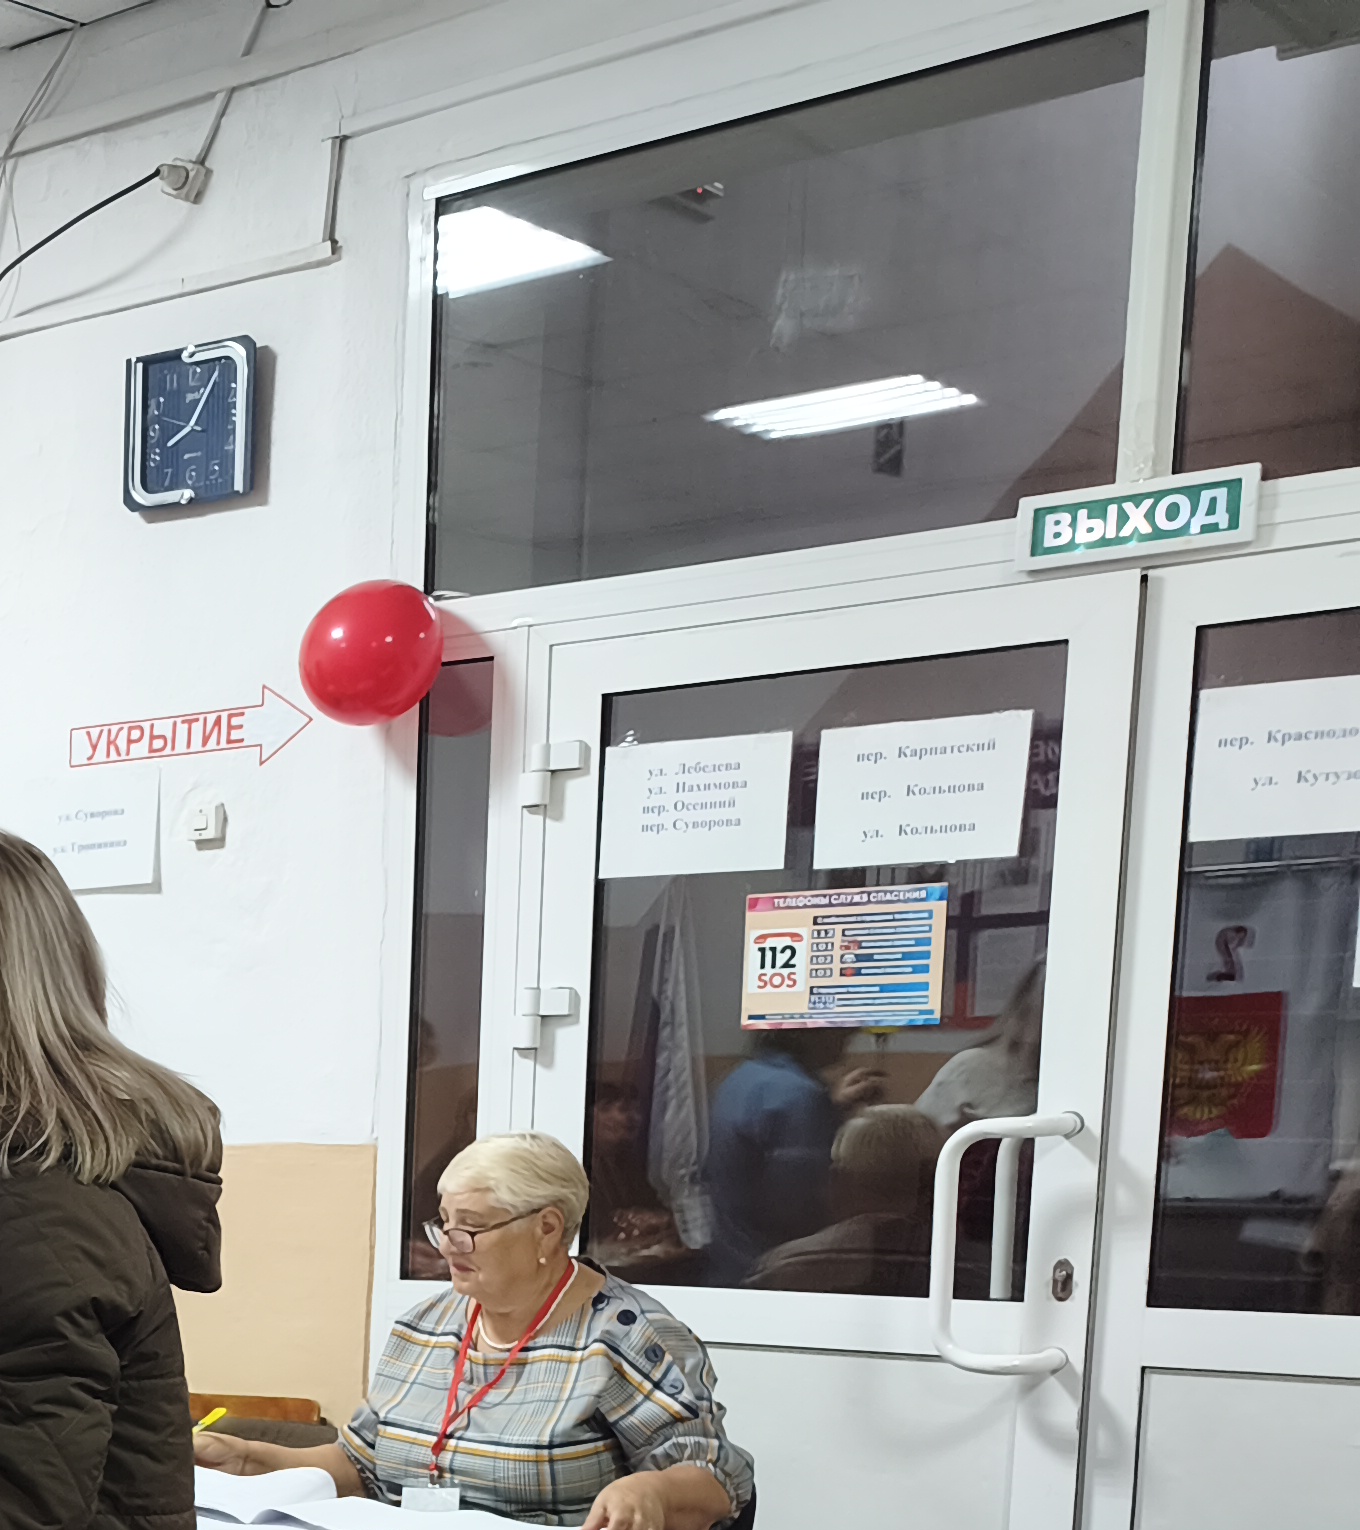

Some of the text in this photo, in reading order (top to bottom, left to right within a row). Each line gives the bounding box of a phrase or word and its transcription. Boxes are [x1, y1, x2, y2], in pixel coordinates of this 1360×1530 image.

[1042, 486, 1231, 549] ВЫХОД
[85, 711, 246, 762] УКРЫТИЕ
[1217, 735, 1255, 751] пер.
[856, 737, 997, 765] пер. Карпатский
[646, 761, 742, 781] ул. Лебедева
[646, 779, 749, 799] ул. Нахимова
[860, 781, 985, 803] пер. Кольцова
[1250, 775, 1279, 792] ул.
[642, 796, 737, 817] пер. Осенний
[641, 817, 742, 835] пер. Суворова
[861, 822, 977, 843] ул. Кольцова
[757, 945, 797, 970] 112
[812, 943, 833, 952] 101
[757, 971, 798, 989] SOS
